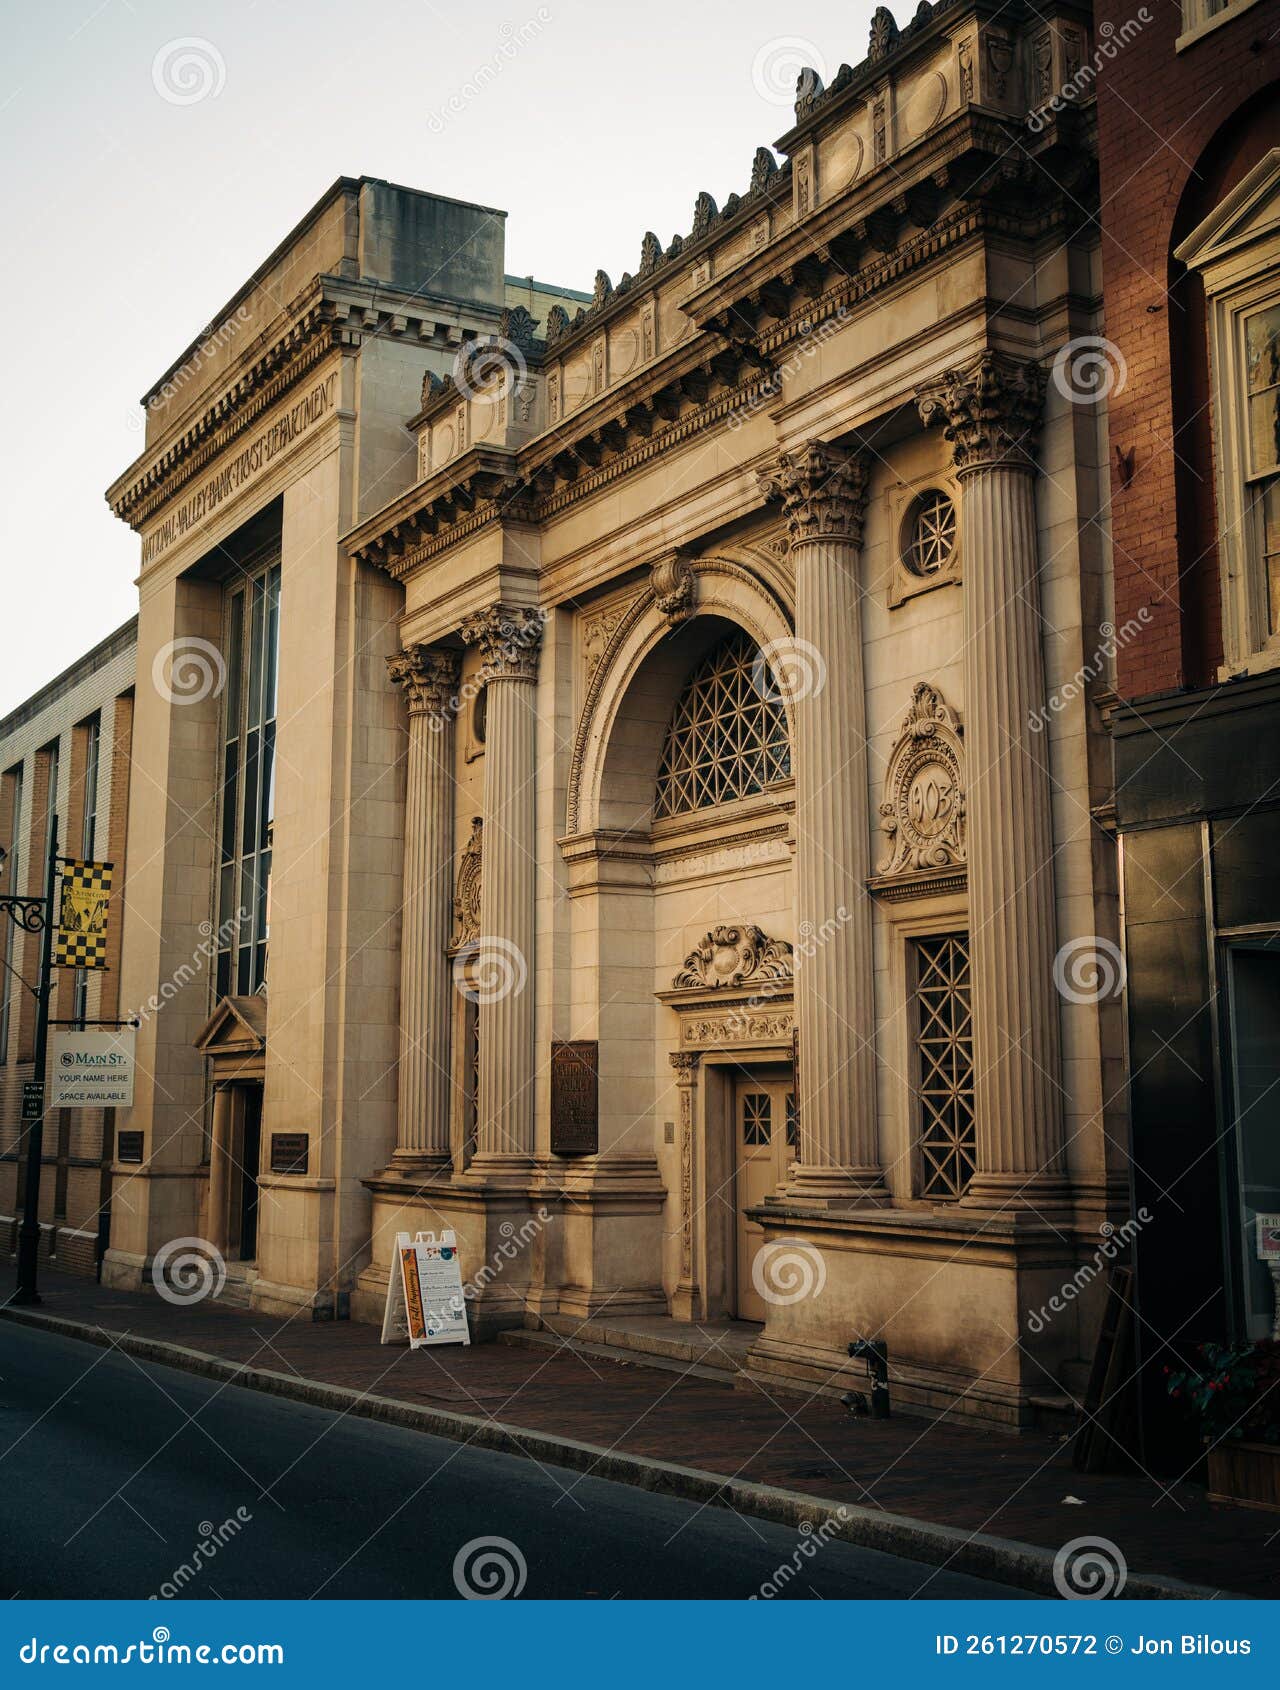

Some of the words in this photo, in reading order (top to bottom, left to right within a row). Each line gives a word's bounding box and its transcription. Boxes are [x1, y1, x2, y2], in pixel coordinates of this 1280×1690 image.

[266, 371, 338, 461] DEPARTMENT
[107, 1074, 128, 1082] HERE
[86, 1092, 127, 1100] AVAILABLE
